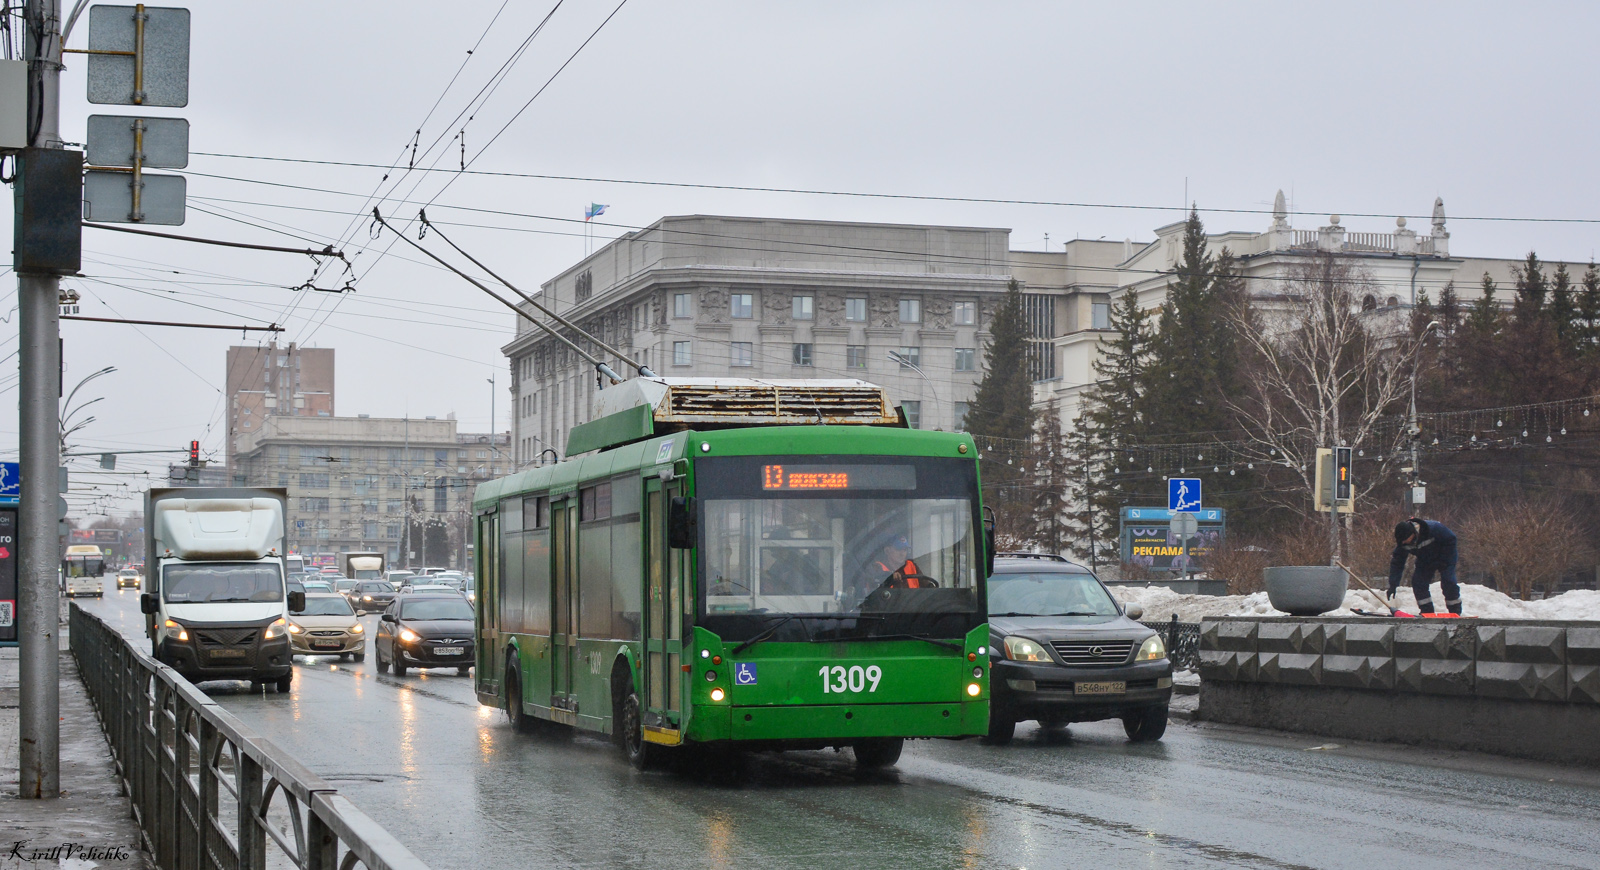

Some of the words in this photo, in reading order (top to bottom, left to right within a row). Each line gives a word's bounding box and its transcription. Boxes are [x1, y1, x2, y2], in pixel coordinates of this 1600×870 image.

[765, 465, 783, 488] 13
[1133, 546, 1183, 556] РЕКЛАМА
[819, 665, 882, 693] 1309
